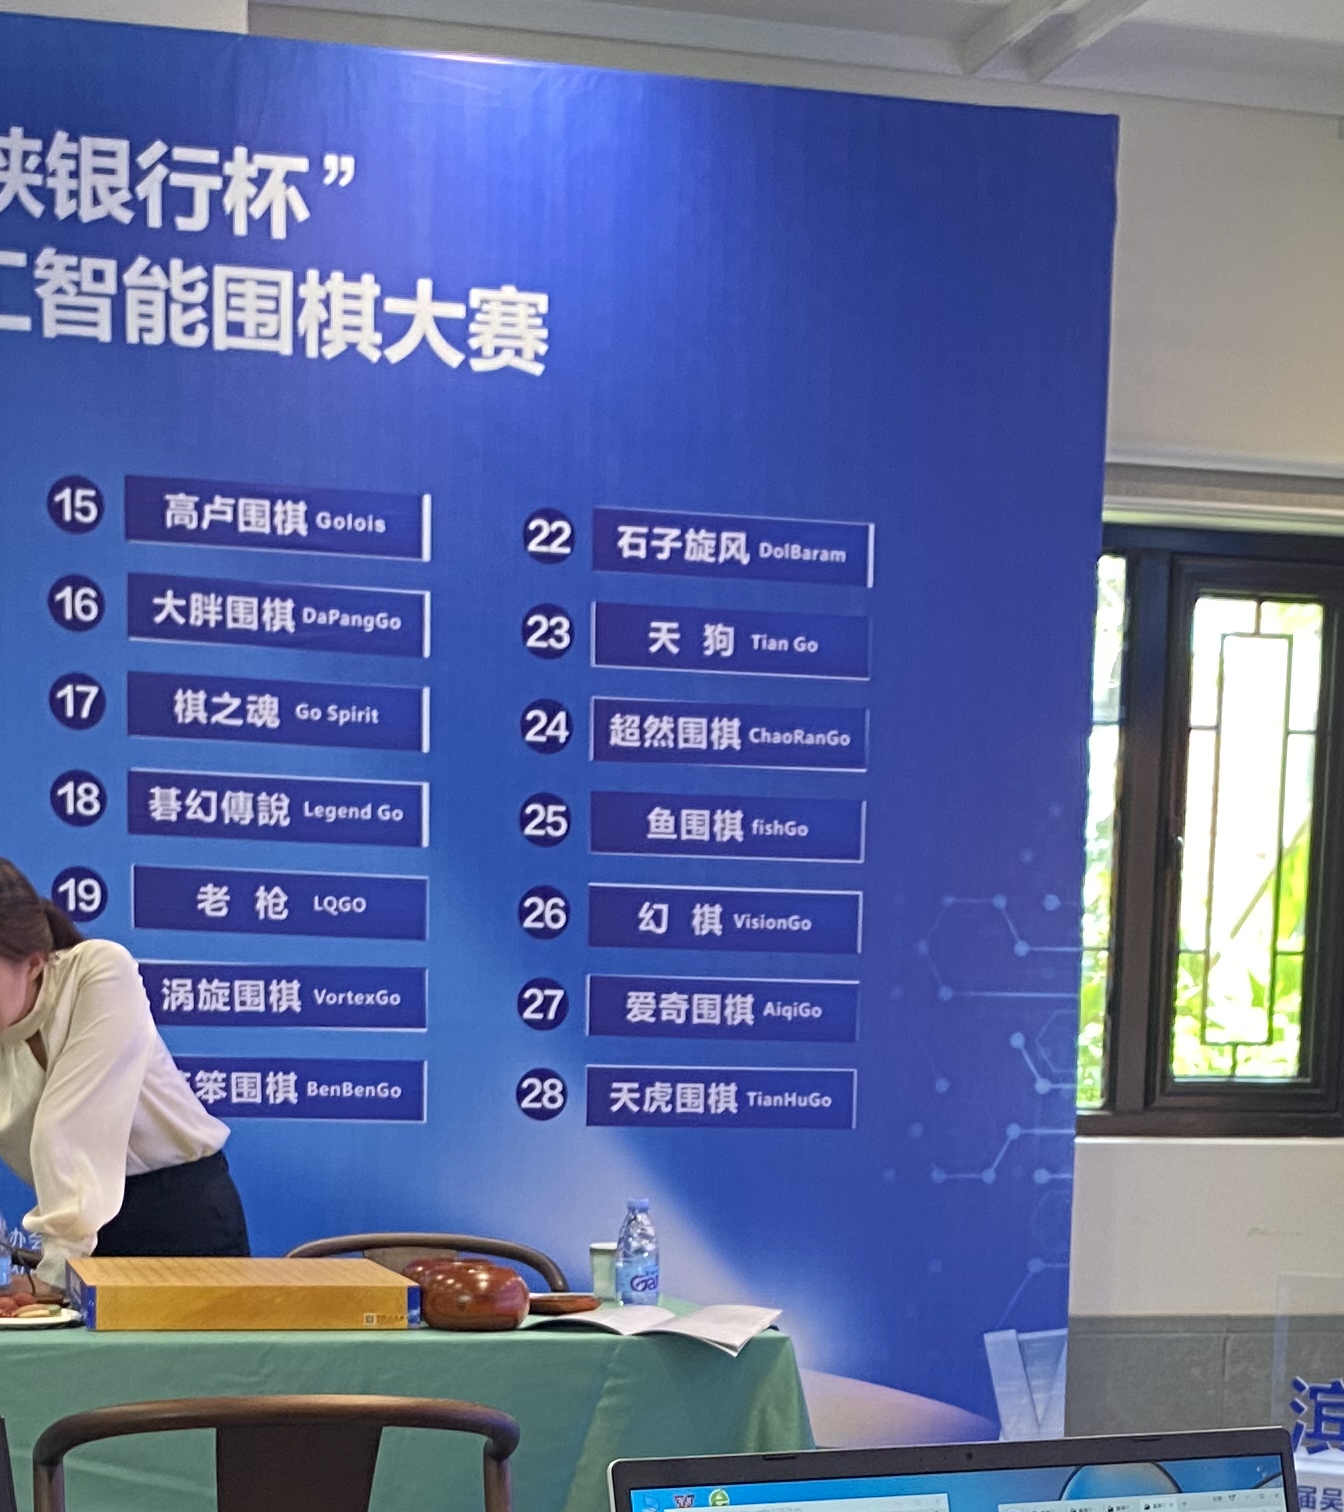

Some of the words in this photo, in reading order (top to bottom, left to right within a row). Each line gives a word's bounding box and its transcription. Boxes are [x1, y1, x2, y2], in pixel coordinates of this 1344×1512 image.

[54, 487, 97, 523] 15
[165, 493, 308, 537] 高卢围棋
[316, 512, 385, 533] Golois
[528, 519, 571, 553] 22
[617, 525, 750, 565] 石子旋风
[759, 542, 846, 562] DolBaram
[55, 586, 98, 621] 16
[153, 590, 295, 633] 大胖围棋
[303, 607, 401, 632] DaPangGo
[527, 615, 570, 649] 23
[751, 634, 789, 650] Tian
[793, 636, 818, 652] Go
[57, 685, 98, 718] 17
[174, 689, 280, 728] 棋之魂
[295, 703, 322, 720] Go
[327, 705, 378, 726] Spirit
[525, 710, 569, 743] 24
[610, 713, 741, 750] 超然围棋
[749, 728, 850, 746] ChaoRanGo
[57, 781, 100, 816] 18
[304, 801, 371, 822] Legend
[377, 805, 403, 821] Go
[524, 804, 567, 837] 25
[647, 807, 744, 842] 鱼围棋
[751, 819, 808, 836] fishGo
[59, 878, 101, 912] 19
[314, 896, 366, 915] LQGO
[523, 897, 566, 929] 26
[733, 914, 812, 930] VisionGo
[162, 978, 301, 1012] 涡旋围棋
[314, 989, 400, 1005] VortexGo
[523, 988, 564, 1019] 27
[626, 992, 754, 1025] 爱奇围棋
[763, 1002, 822, 1021] AiqiGo
[181, 1071, 298, 1105] 笨围棋
[307, 1081, 401, 1098] BenBenGo
[520, 1078, 564, 1110] 28
[610, 1082, 738, 1114] 天虎围棋
[747, 1092, 832, 1107] TianHuGo
